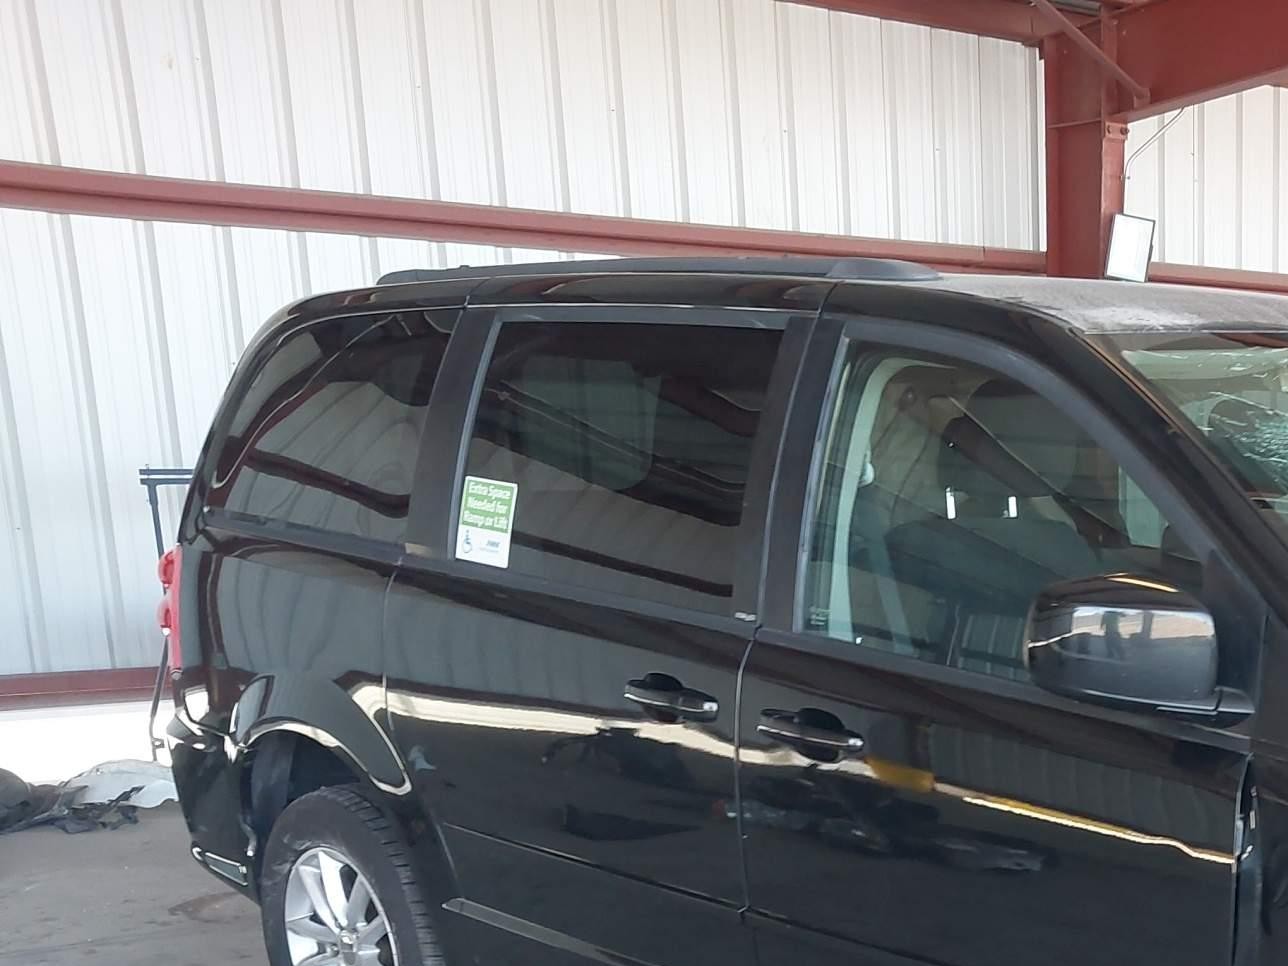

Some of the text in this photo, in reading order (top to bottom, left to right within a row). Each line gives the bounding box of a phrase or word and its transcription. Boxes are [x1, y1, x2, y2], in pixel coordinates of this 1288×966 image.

[488, 485, 511, 499] Space
[467, 497, 508, 514] Needed for
[463, 510, 508, 529] Ramp or Lift
